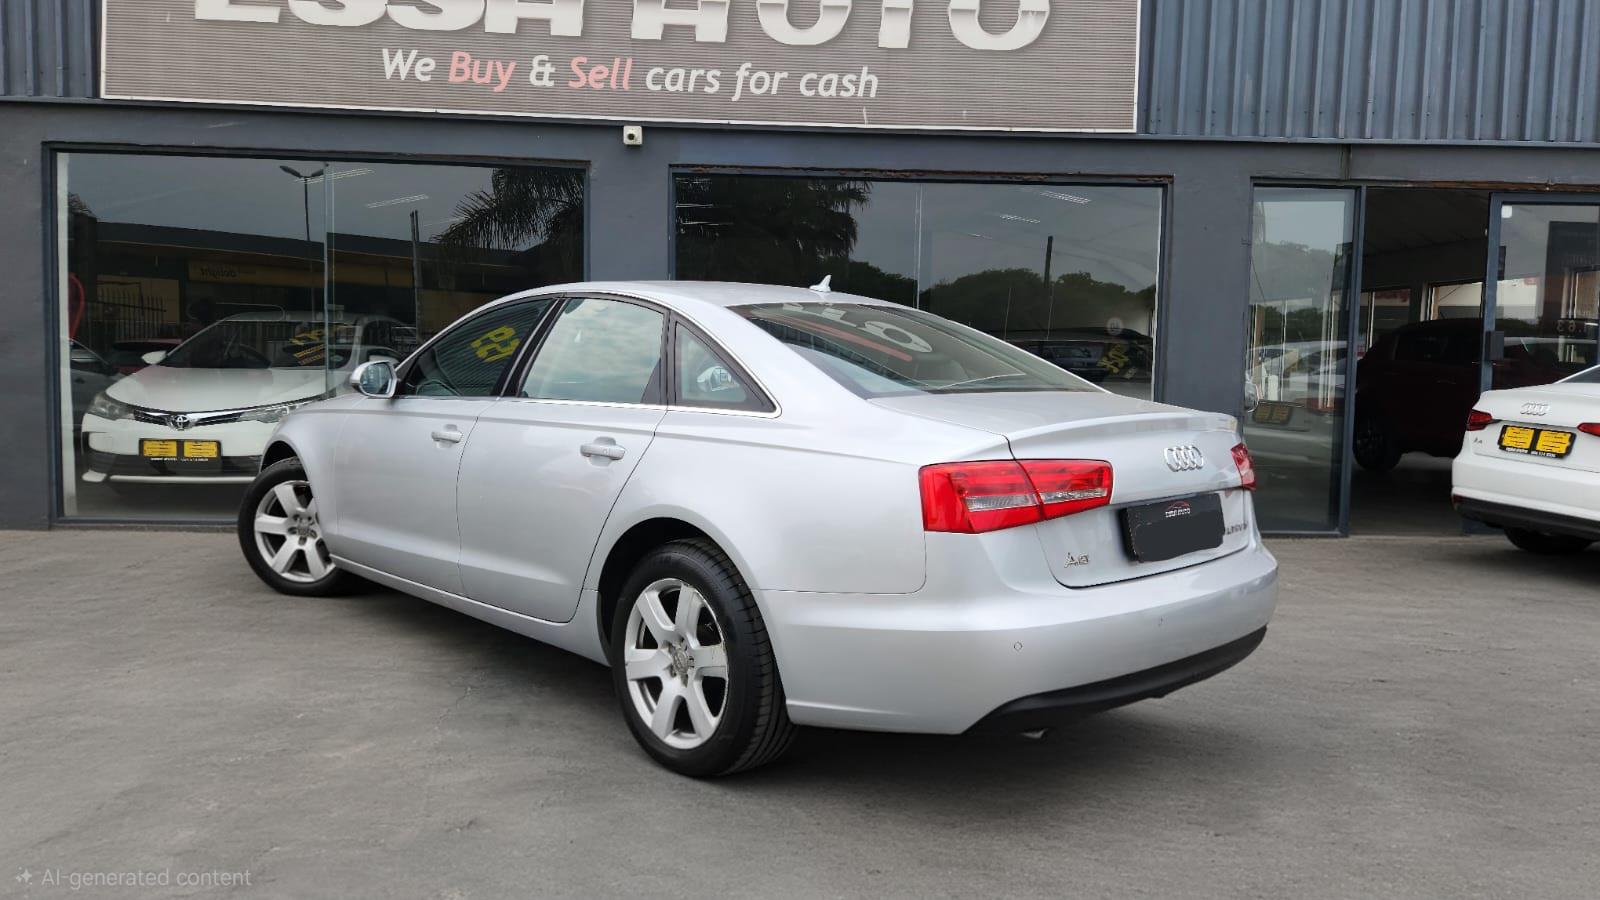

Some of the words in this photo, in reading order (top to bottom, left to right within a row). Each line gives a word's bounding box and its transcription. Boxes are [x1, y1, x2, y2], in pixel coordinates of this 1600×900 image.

[382, 48, 436, 82] We
[448, 51, 516, 92] Buy
[529, 54, 556, 87] &
[568, 56, 632, 91] Sell
[646, 66, 721, 94] cars
[731, 62, 789, 102] for
[799, 65, 878, 98] cash
